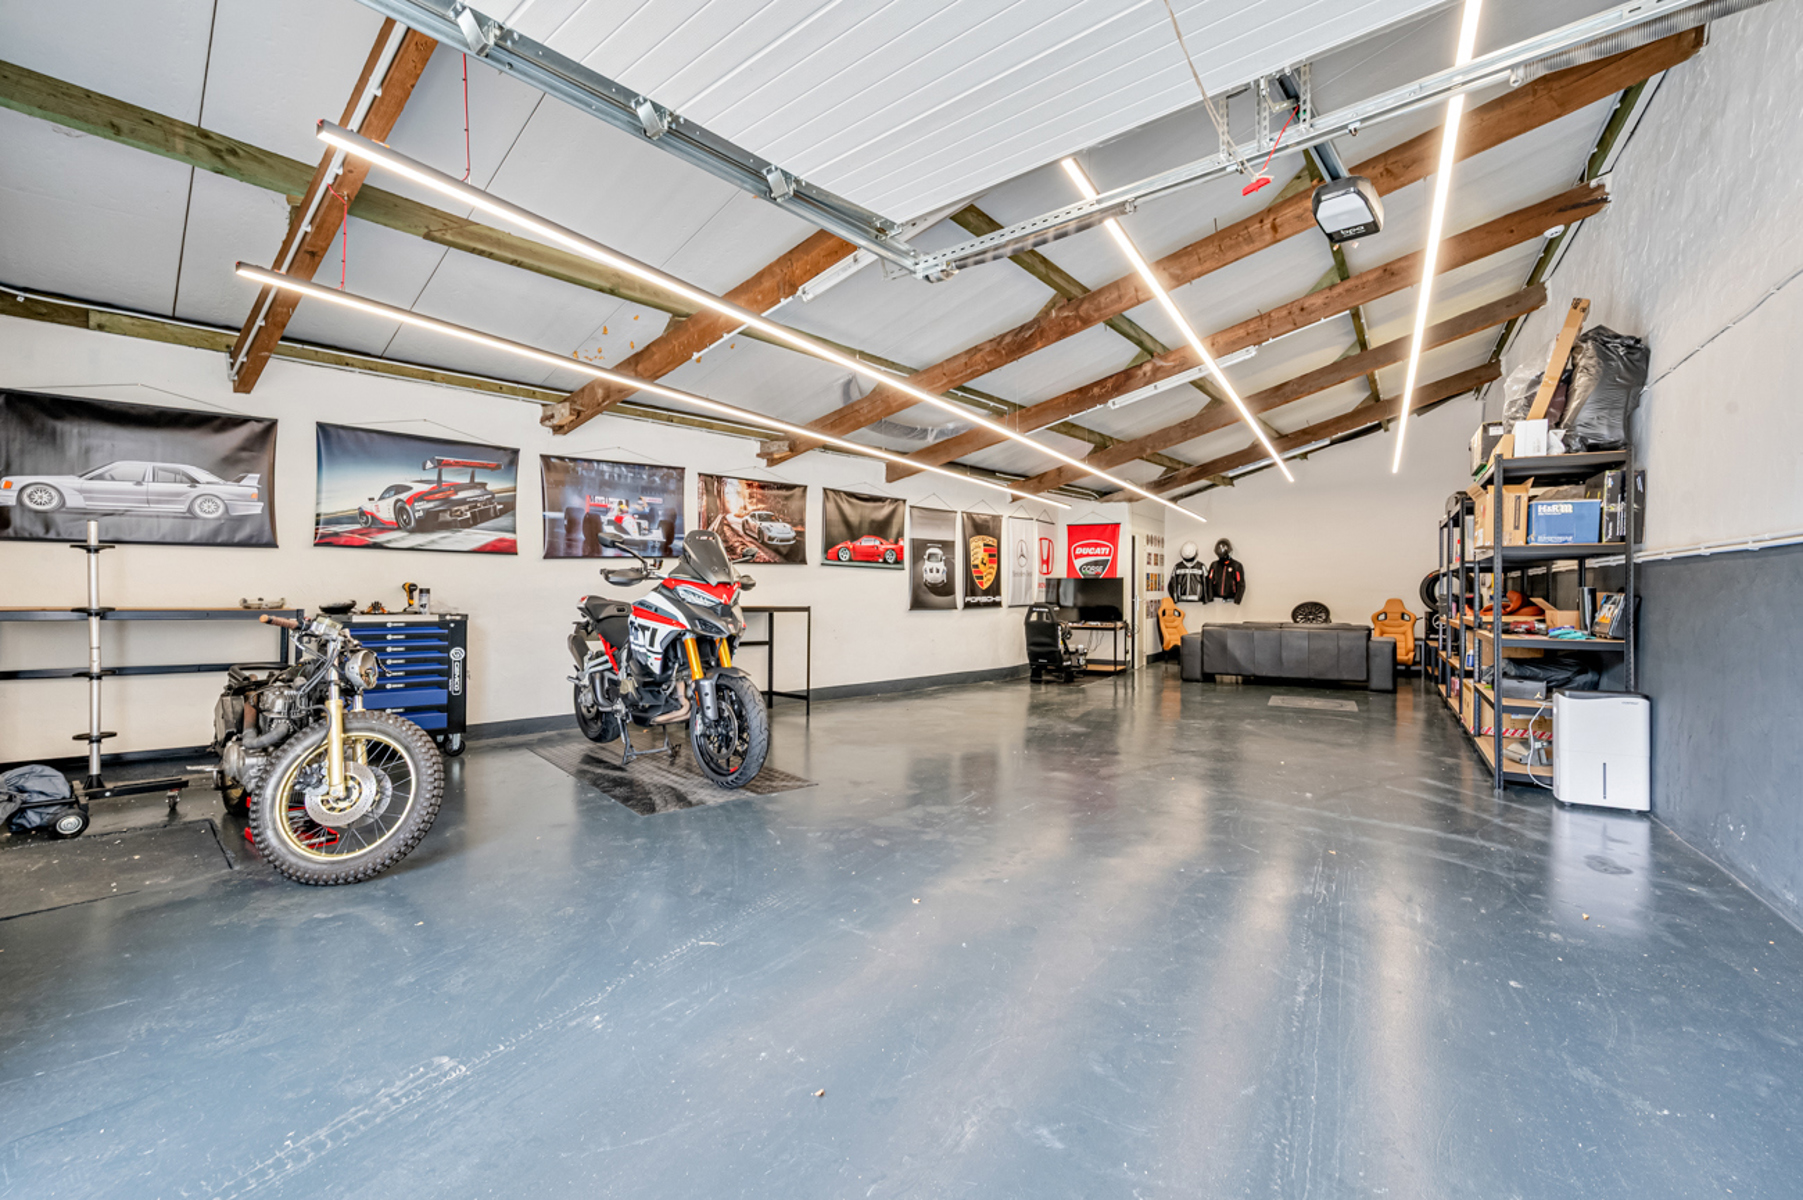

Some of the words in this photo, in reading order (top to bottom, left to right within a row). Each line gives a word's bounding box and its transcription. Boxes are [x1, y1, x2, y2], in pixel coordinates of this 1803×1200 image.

[1075, 547, 1110, 555] DUCATI
[1081, 565, 1103, 575] CORSE
[965, 595, 1002, 603] PORSCHE
